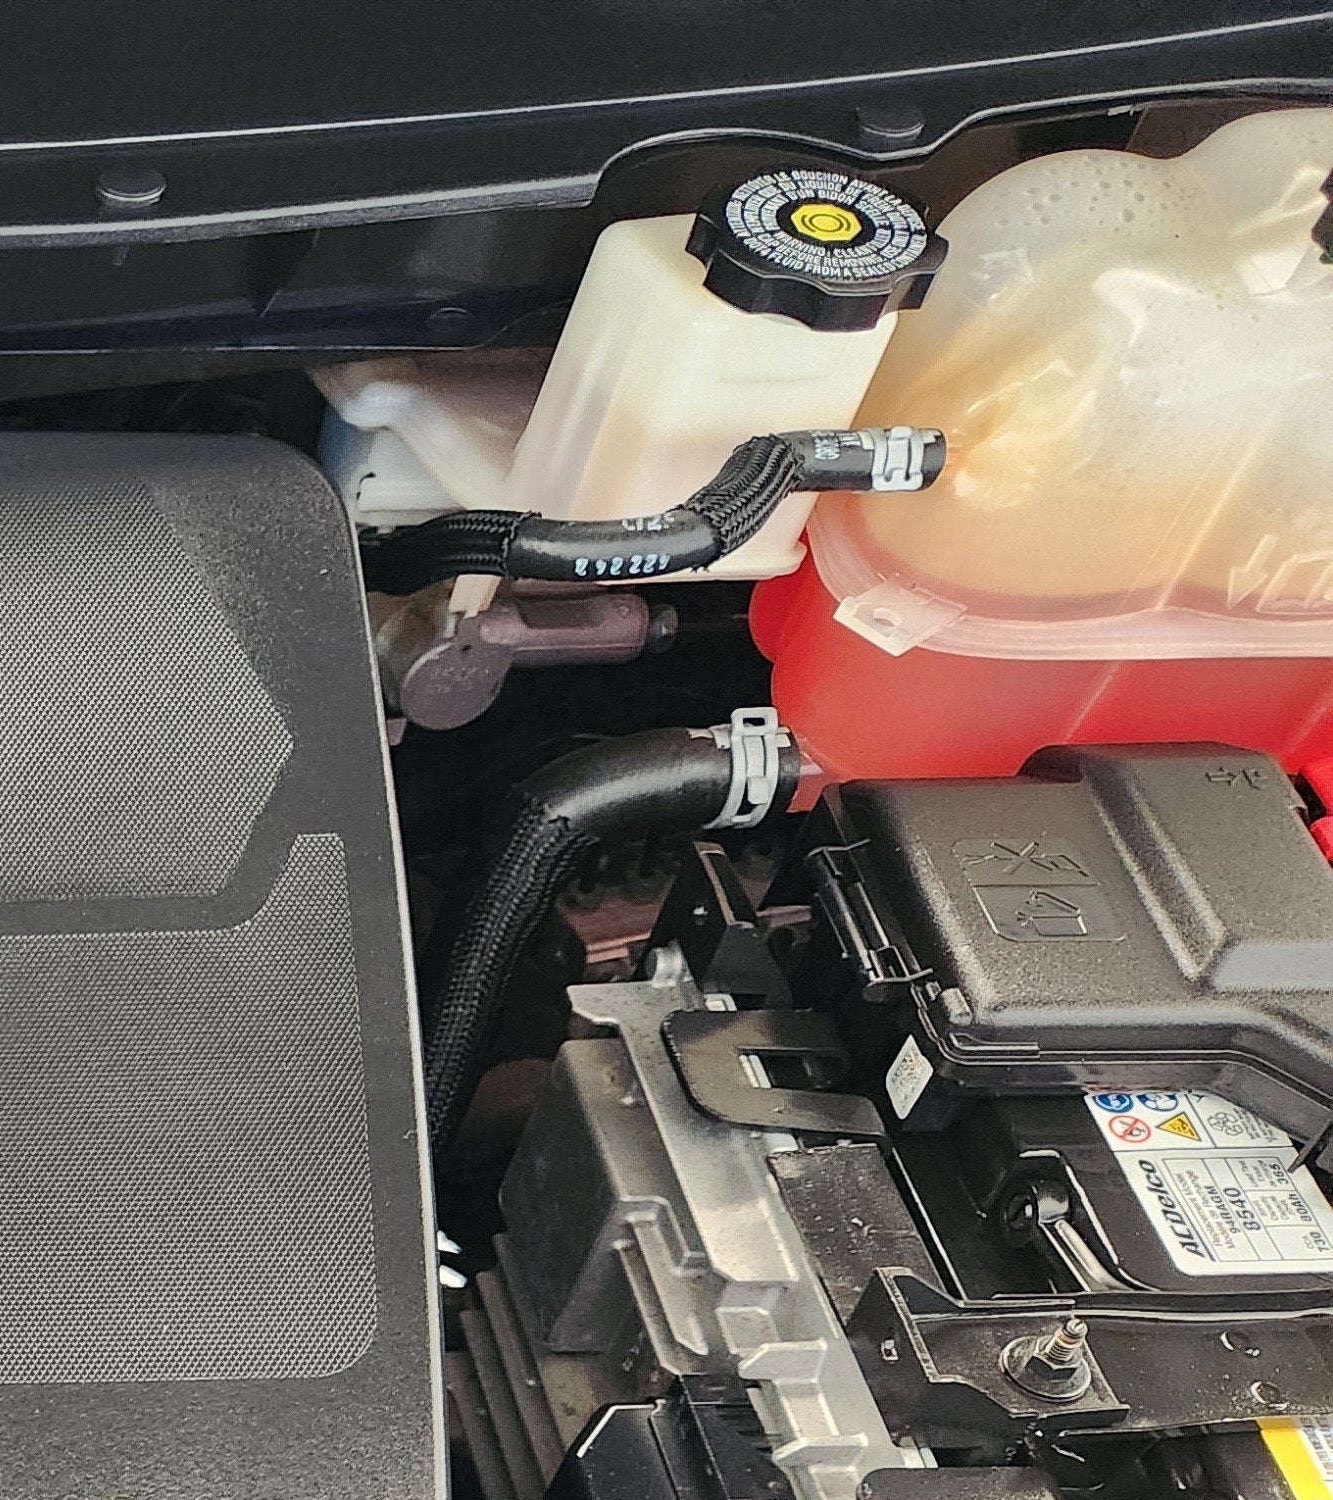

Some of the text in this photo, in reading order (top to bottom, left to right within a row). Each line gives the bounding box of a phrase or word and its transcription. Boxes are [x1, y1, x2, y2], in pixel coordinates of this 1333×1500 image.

[792, 171, 848, 184] BOUCHON
[778, 181, 797, 192] DU
[798, 180, 842, 192] LIQUIDE
[845, 186, 863, 198] DE
[818, 189, 856, 205] BIDON
[776, 244, 821, 265] BEFORE
[833, 243, 874, 258] CLEAN
[768, 252, 804, 270] FLUID
[804, 263, 841, 277] FROM
[841, 268, 853, 278] A
[852, 262, 896, 277] SEALED
[1269, 1164, 1289, 1185] 365
[1139, 1160, 1204, 1257] ACDelco
[1204, 1186, 1240, 1234] 94RAGM
[1223, 1188, 1260, 1231] 8540
[1287, 1193, 1312, 1222] 80Ah
[1309, 1232, 1329, 1252] 730
